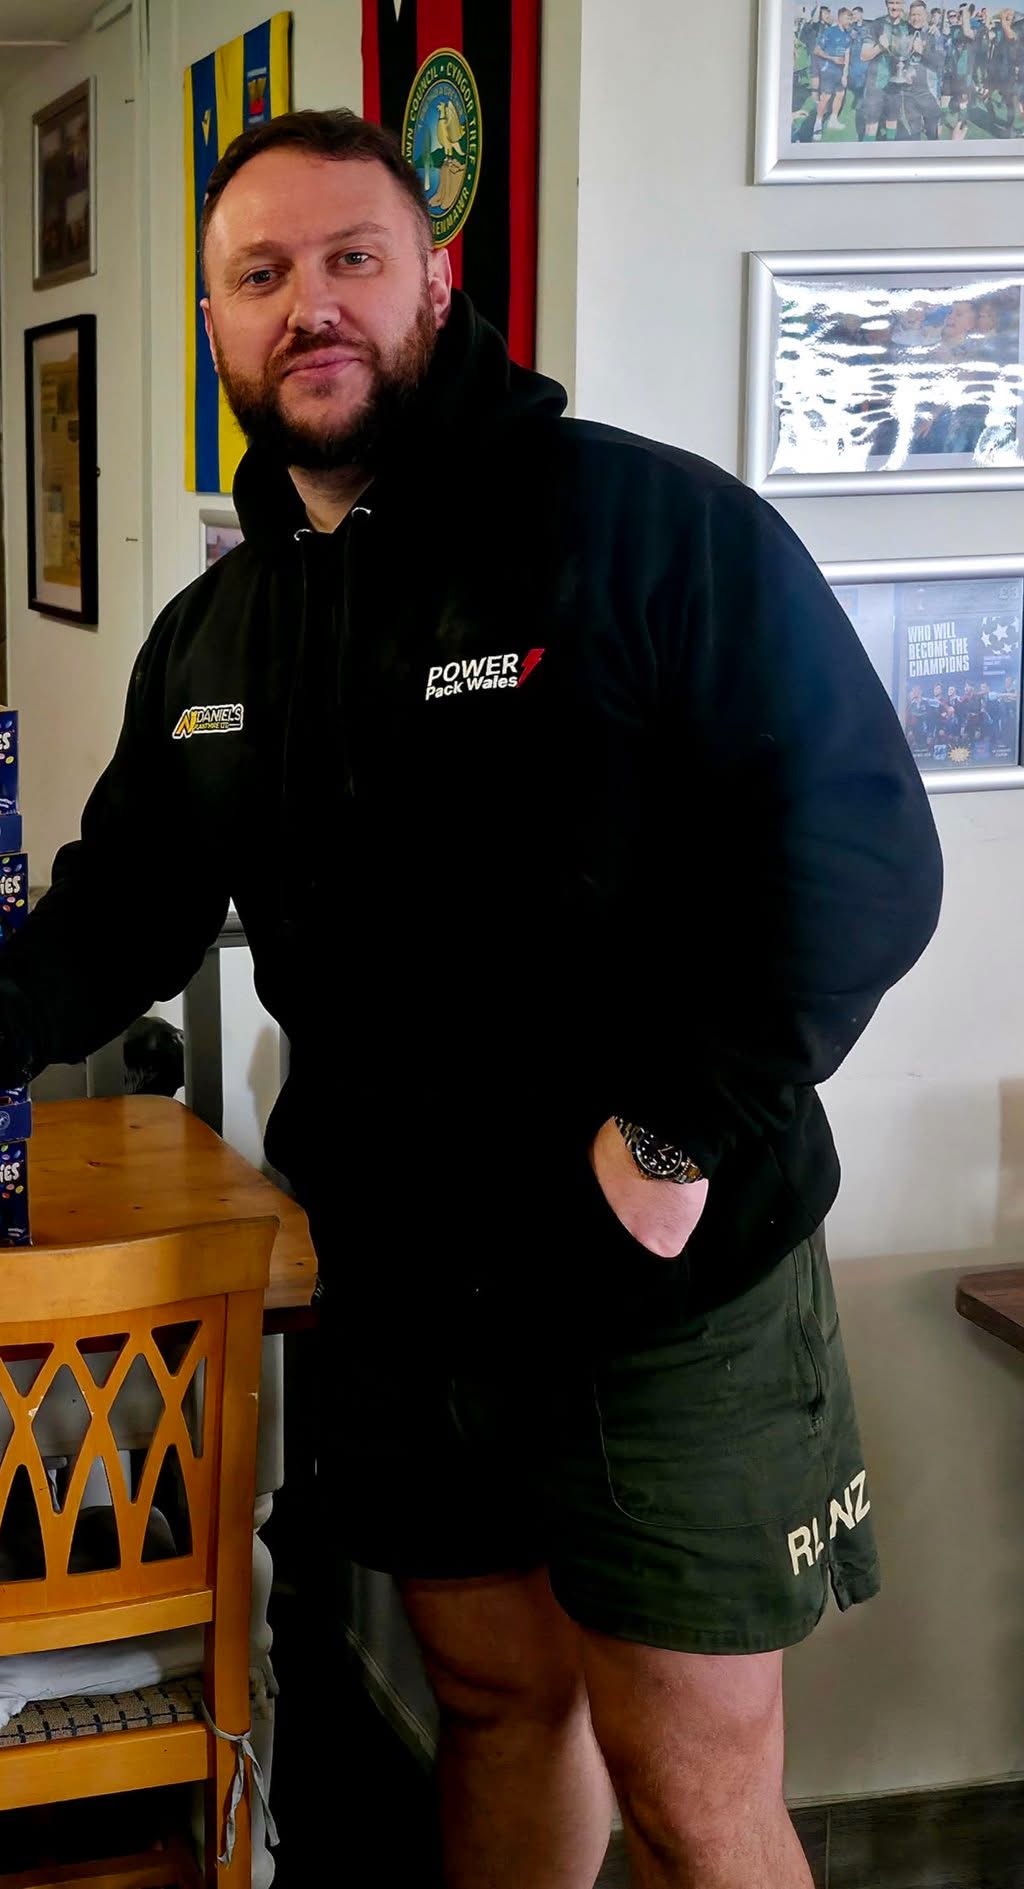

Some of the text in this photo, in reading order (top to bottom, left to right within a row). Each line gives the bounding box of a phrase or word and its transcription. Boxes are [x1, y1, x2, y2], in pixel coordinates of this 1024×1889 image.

[409, 66, 438, 121] COUNCIL
[446, 62, 474, 114] CYNGOR
[907, 621, 957, 642] WHO WILL
[908, 637, 969, 660] BECOME THE
[427, 653, 519, 687] POWER
[909, 654, 970, 678] CHAMPIONS
[425, 675, 518, 701] Pack Wales
